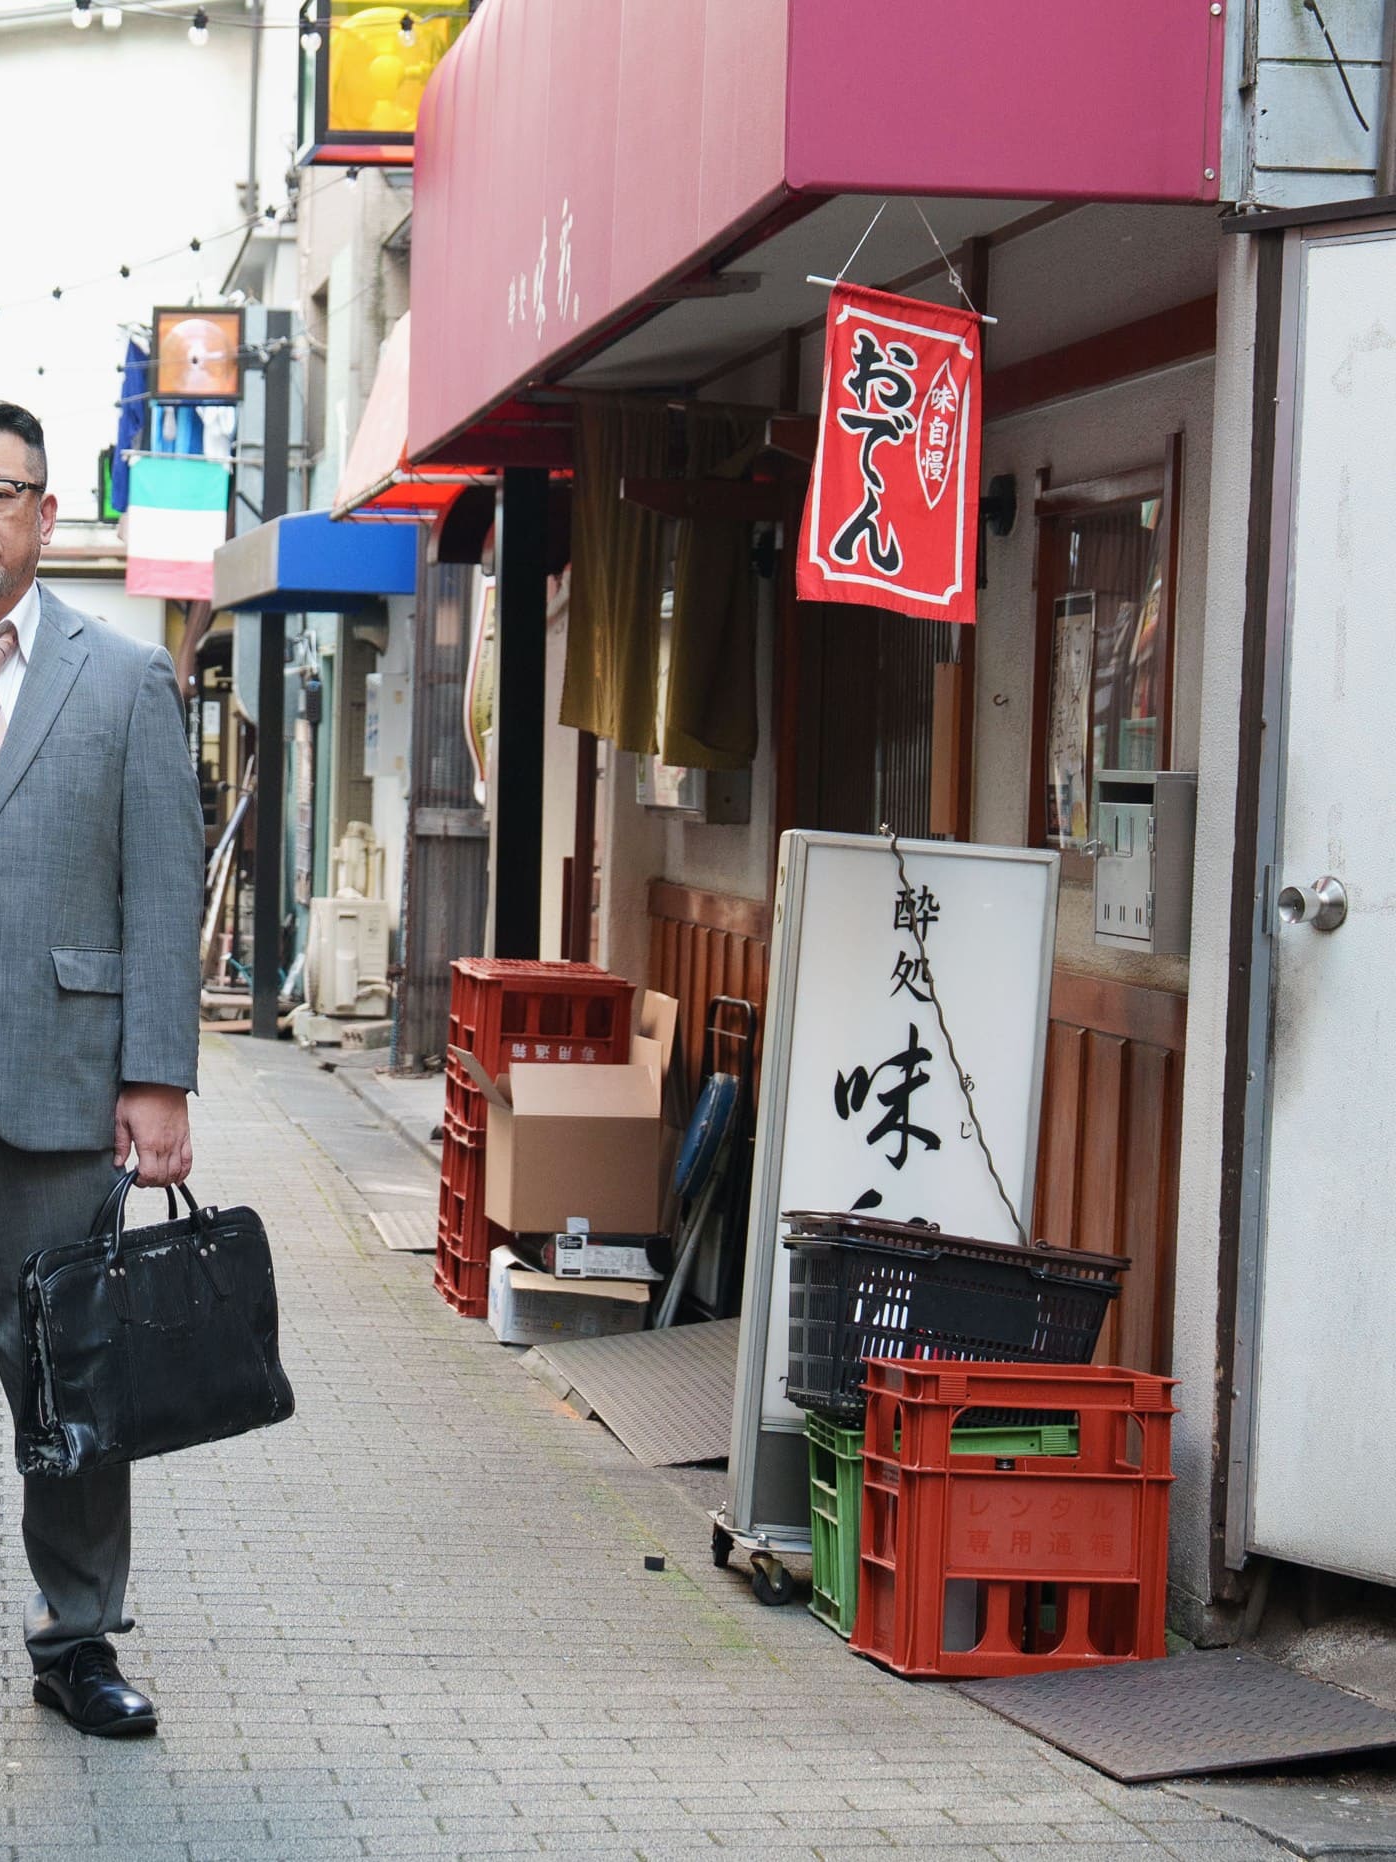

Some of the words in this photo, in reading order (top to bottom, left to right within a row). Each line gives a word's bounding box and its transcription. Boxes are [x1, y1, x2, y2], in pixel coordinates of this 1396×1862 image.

[831, 330, 917, 575] おでん
[921, 386, 956, 483] 味自慢
[890, 884, 941, 1002] 酔処
[966, 1529, 1116, 1558] 専用通箱
[968, 1492, 1116, 1520] レンタル
